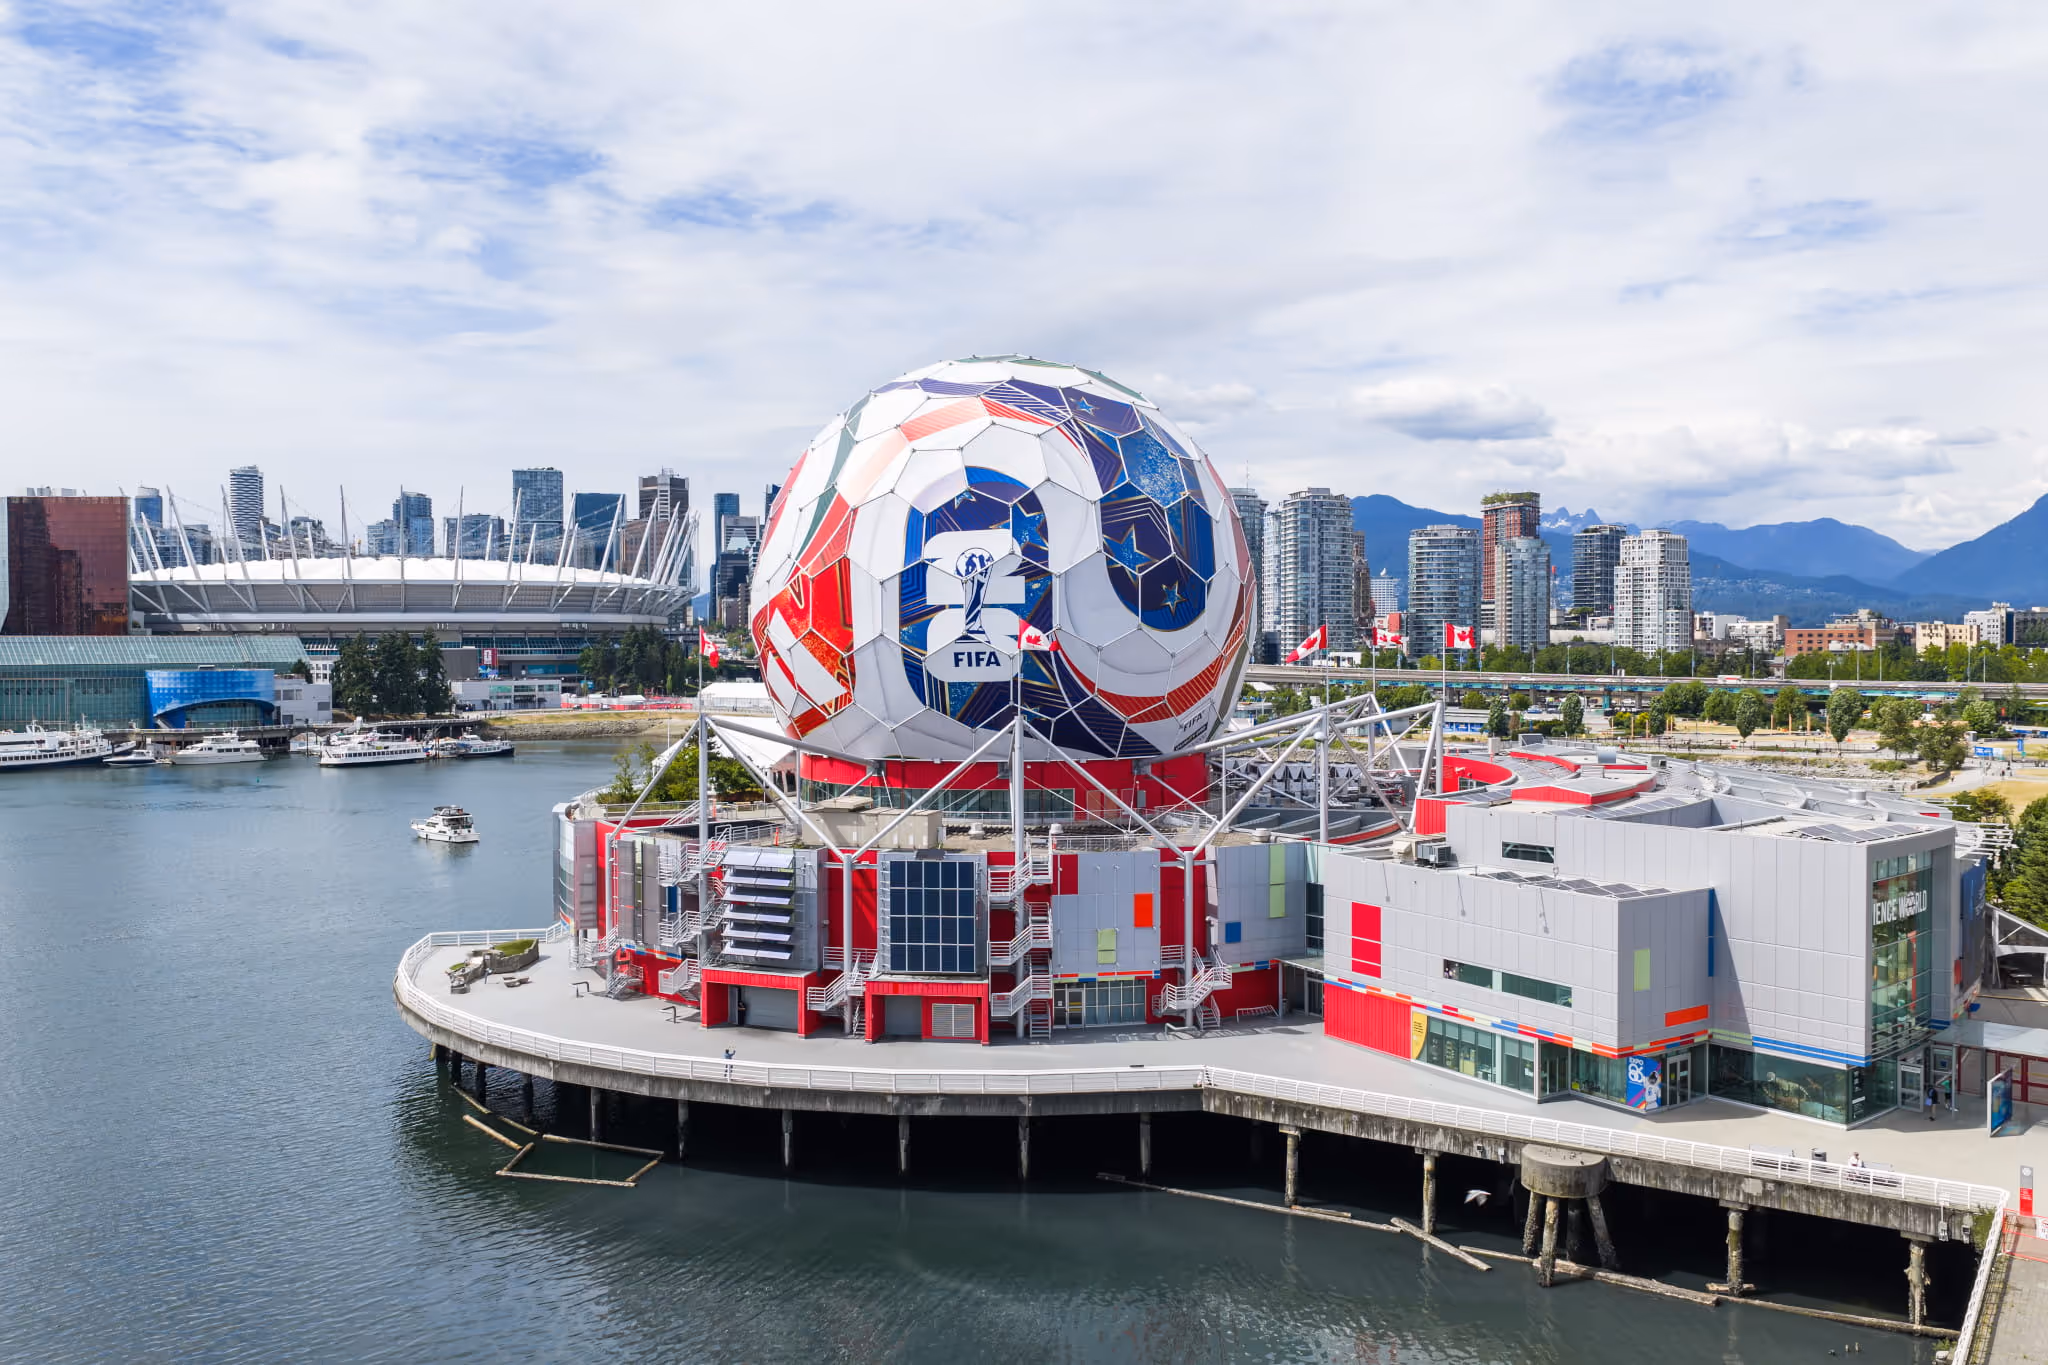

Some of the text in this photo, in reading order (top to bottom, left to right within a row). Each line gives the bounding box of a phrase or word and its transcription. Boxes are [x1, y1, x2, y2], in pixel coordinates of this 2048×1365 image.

[953, 651, 1001, 668] FIFA
[1183, 712, 1202, 732] FIFA
[1873, 889, 1927, 925] IENCE WORLD
